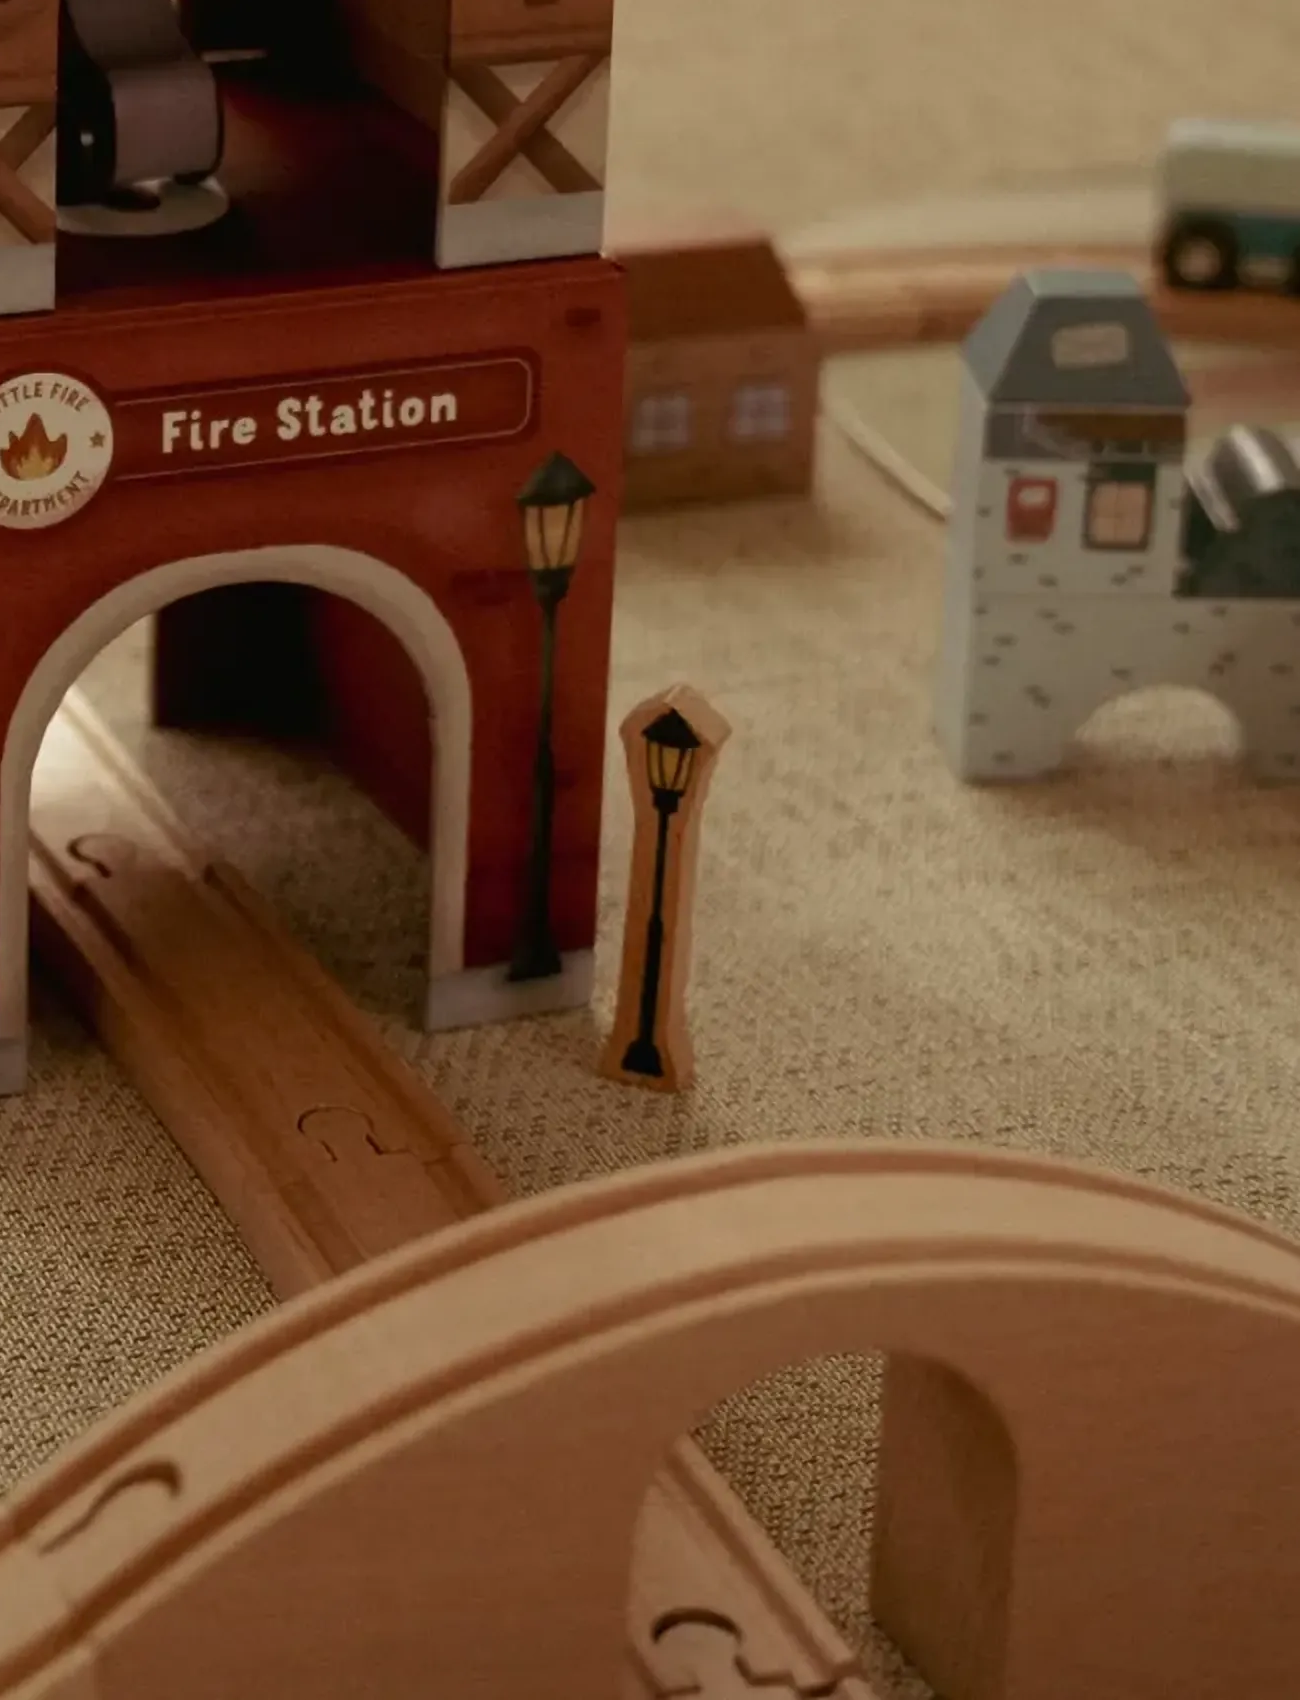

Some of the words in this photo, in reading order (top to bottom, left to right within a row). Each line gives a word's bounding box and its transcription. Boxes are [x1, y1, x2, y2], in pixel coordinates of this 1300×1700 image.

[50, 382, 90, 412] FIRE
[161, 410, 257, 453] Fire
[276, 389, 457, 441] Station
